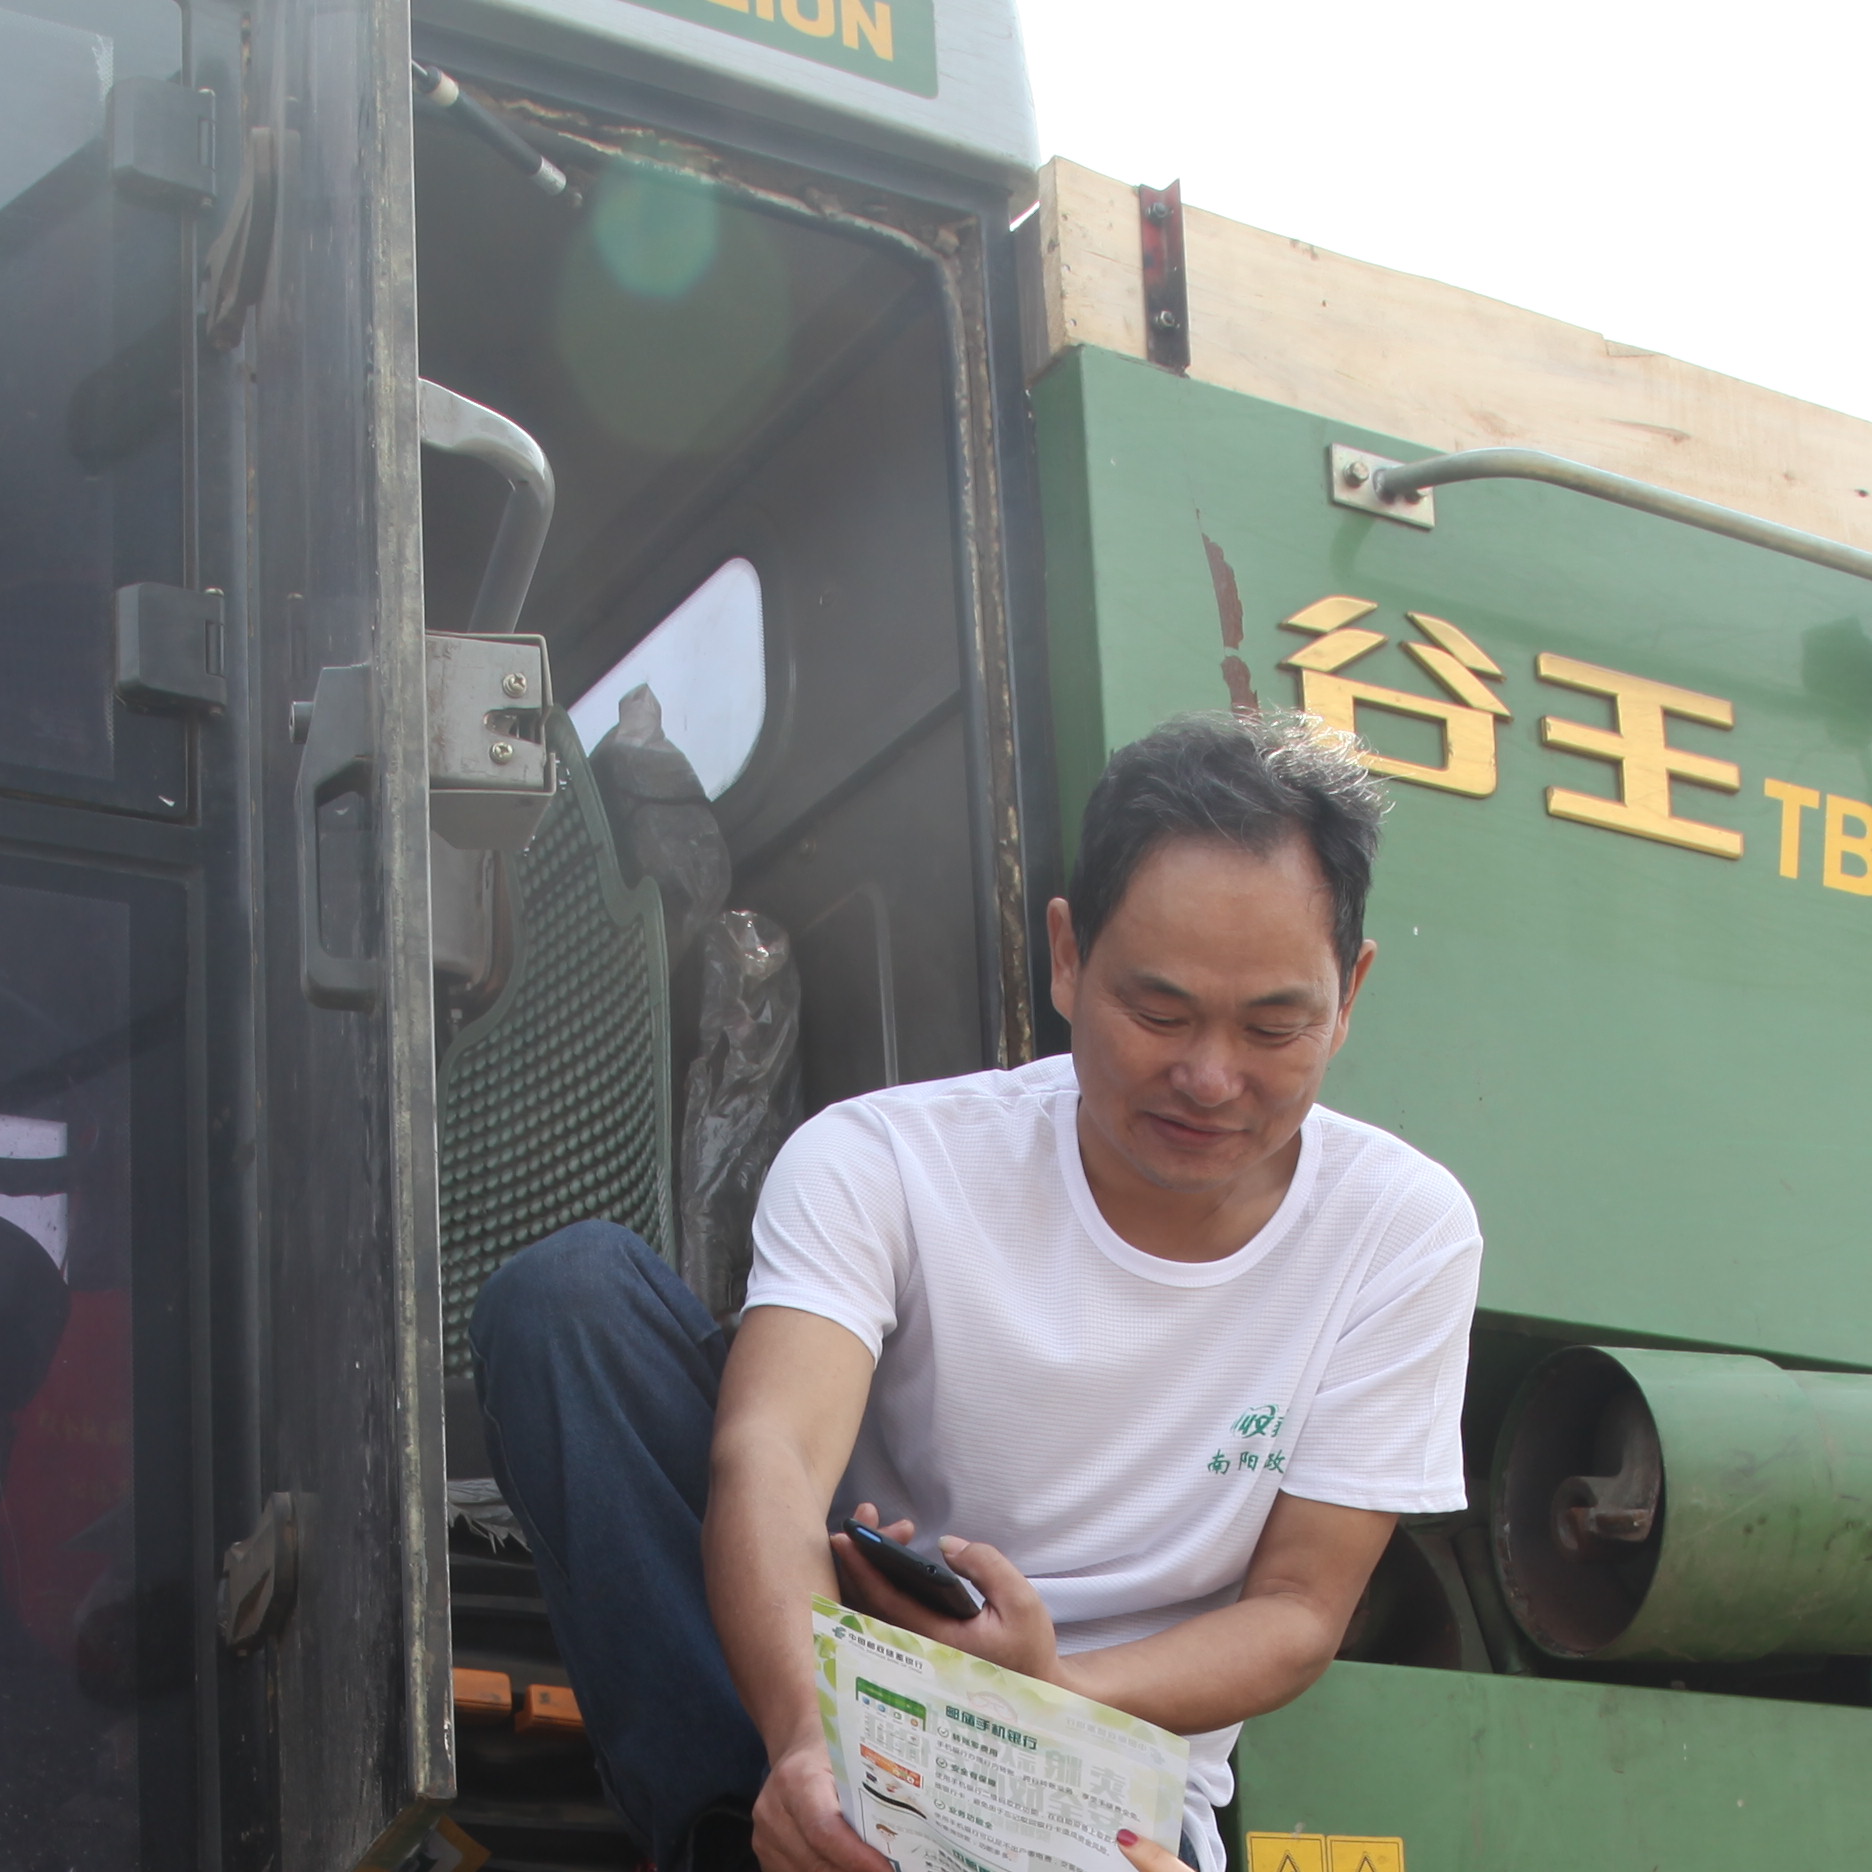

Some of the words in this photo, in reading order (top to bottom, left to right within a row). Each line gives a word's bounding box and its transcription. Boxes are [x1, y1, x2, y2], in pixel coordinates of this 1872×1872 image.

[1278, 595, 1744, 860] 谷王
[945, 1705, 1037, 1750] 邮储手机银行
